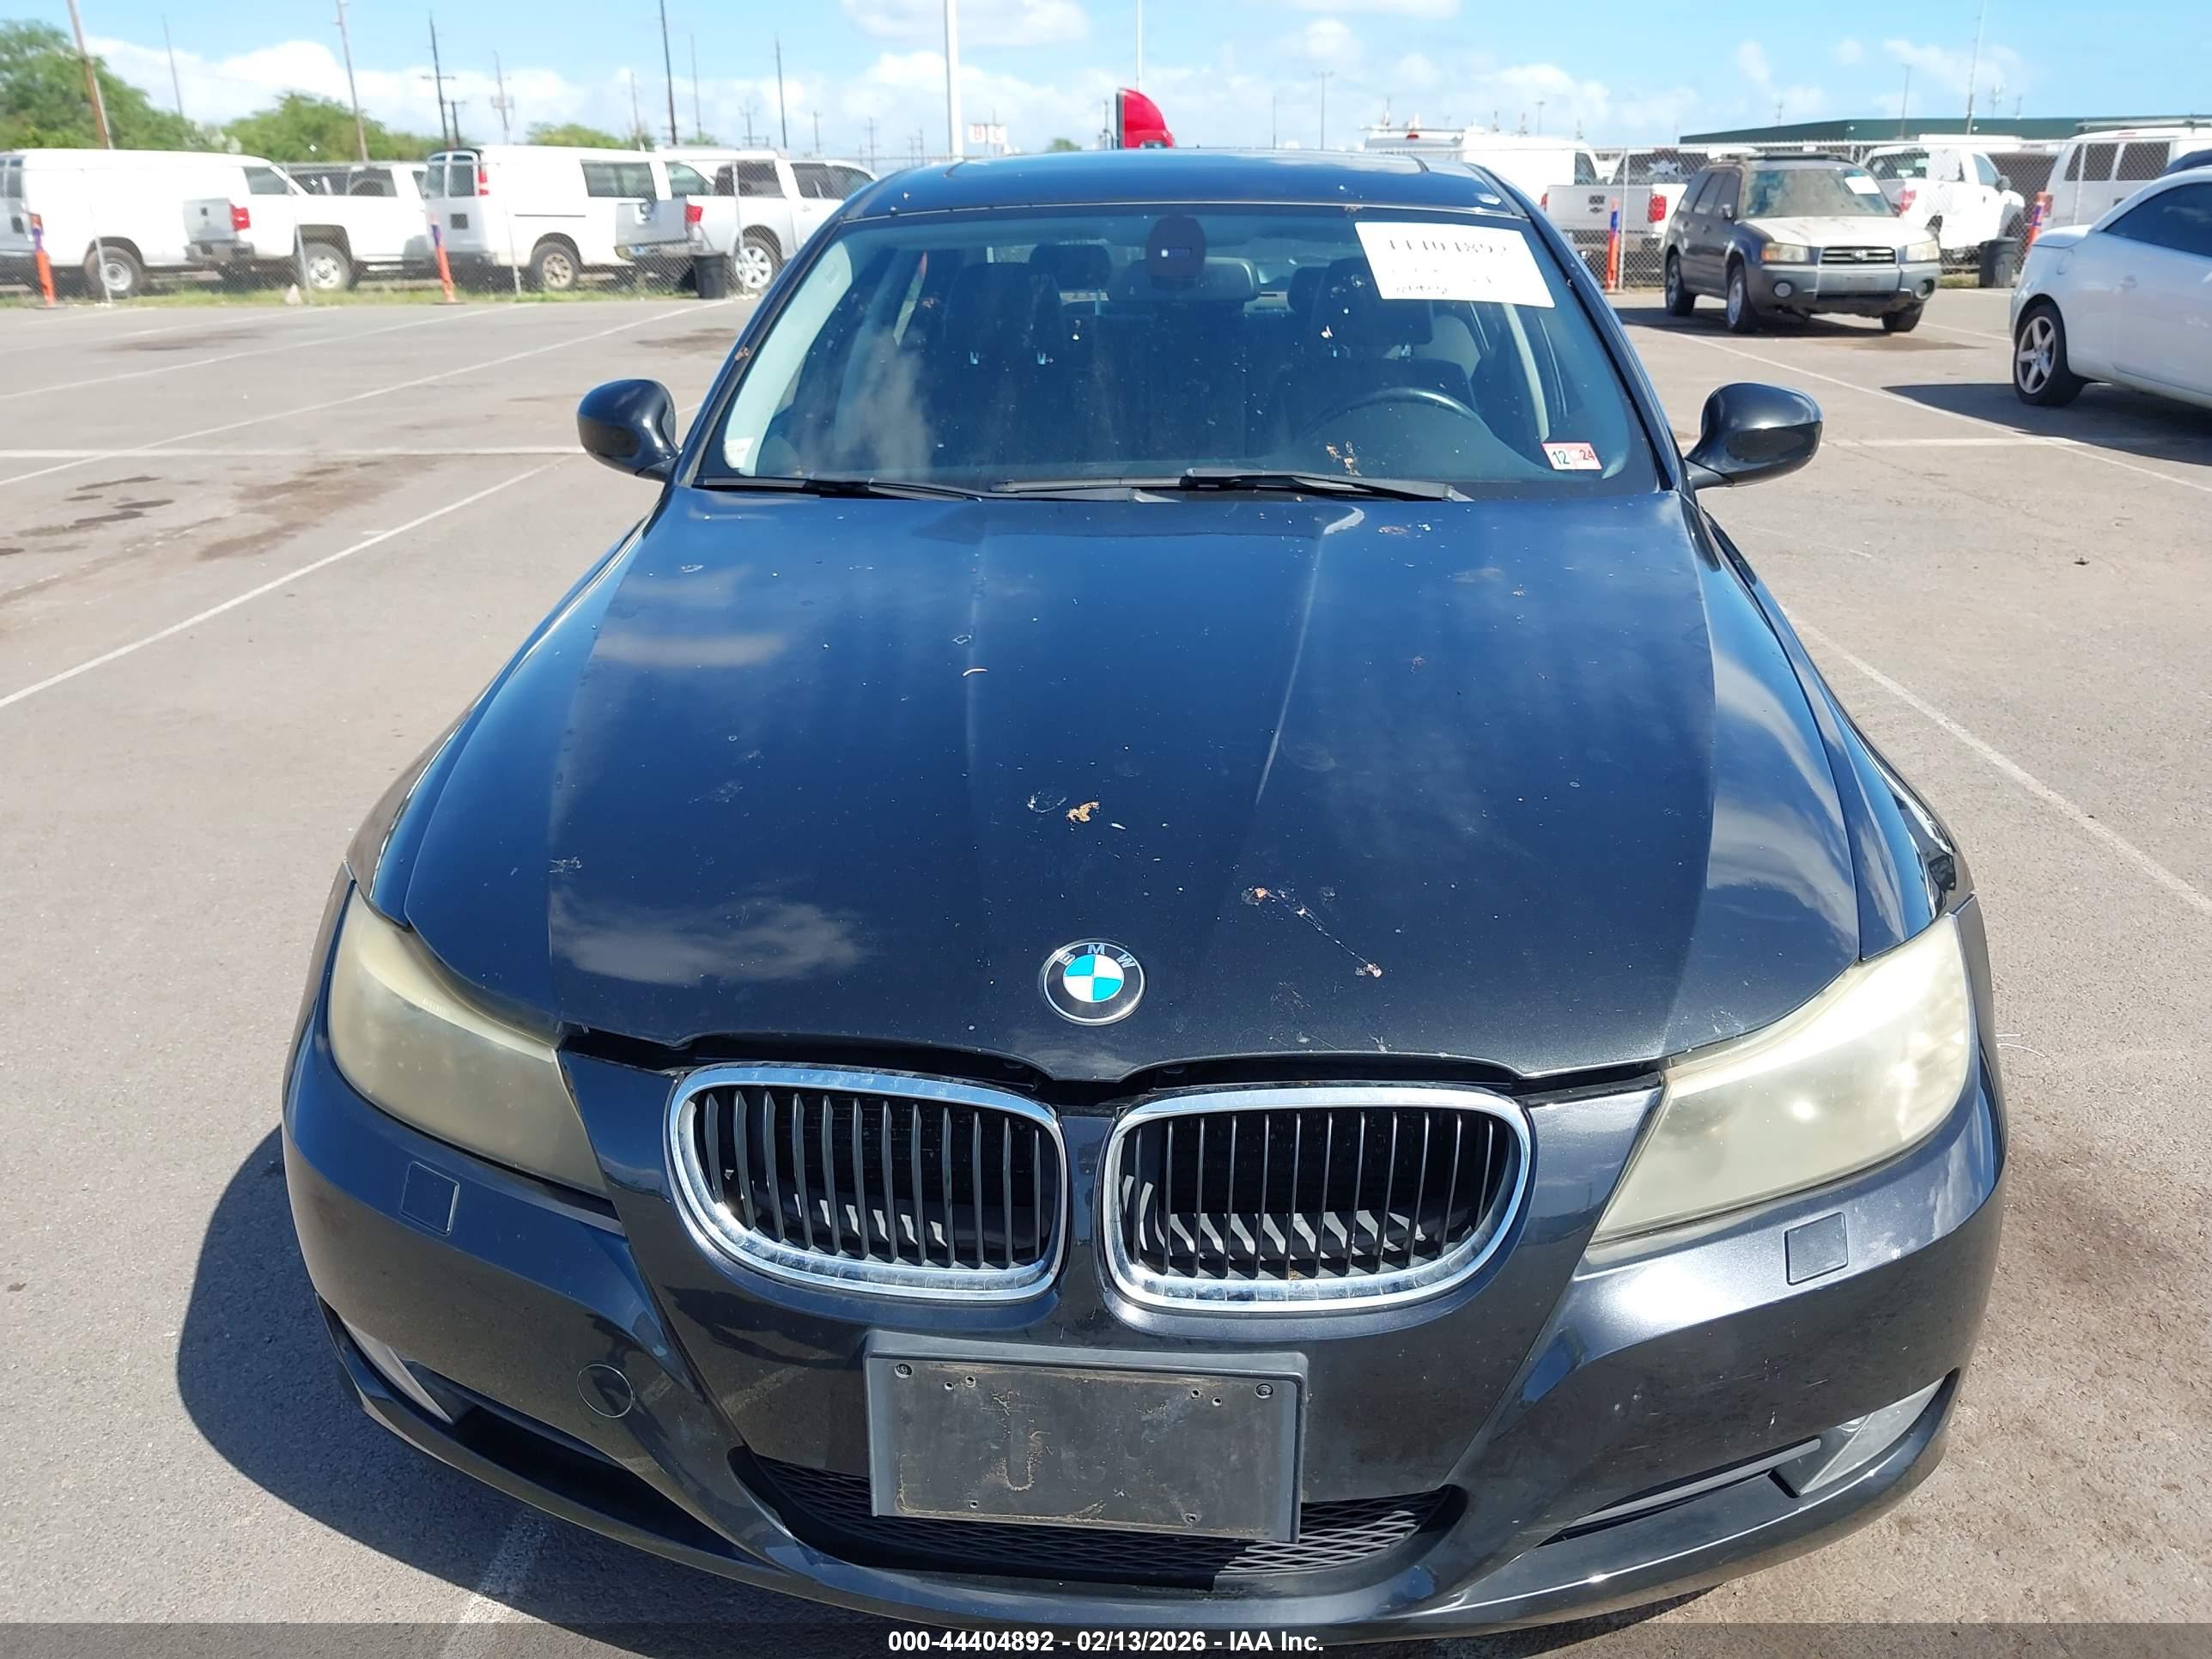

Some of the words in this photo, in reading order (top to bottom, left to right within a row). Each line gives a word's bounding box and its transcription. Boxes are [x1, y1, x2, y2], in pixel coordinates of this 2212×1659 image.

[1552, 450, 1571, 465] 12
[1579, 449, 1595, 461] 24
[1055, 943, 1137, 969] BMW
